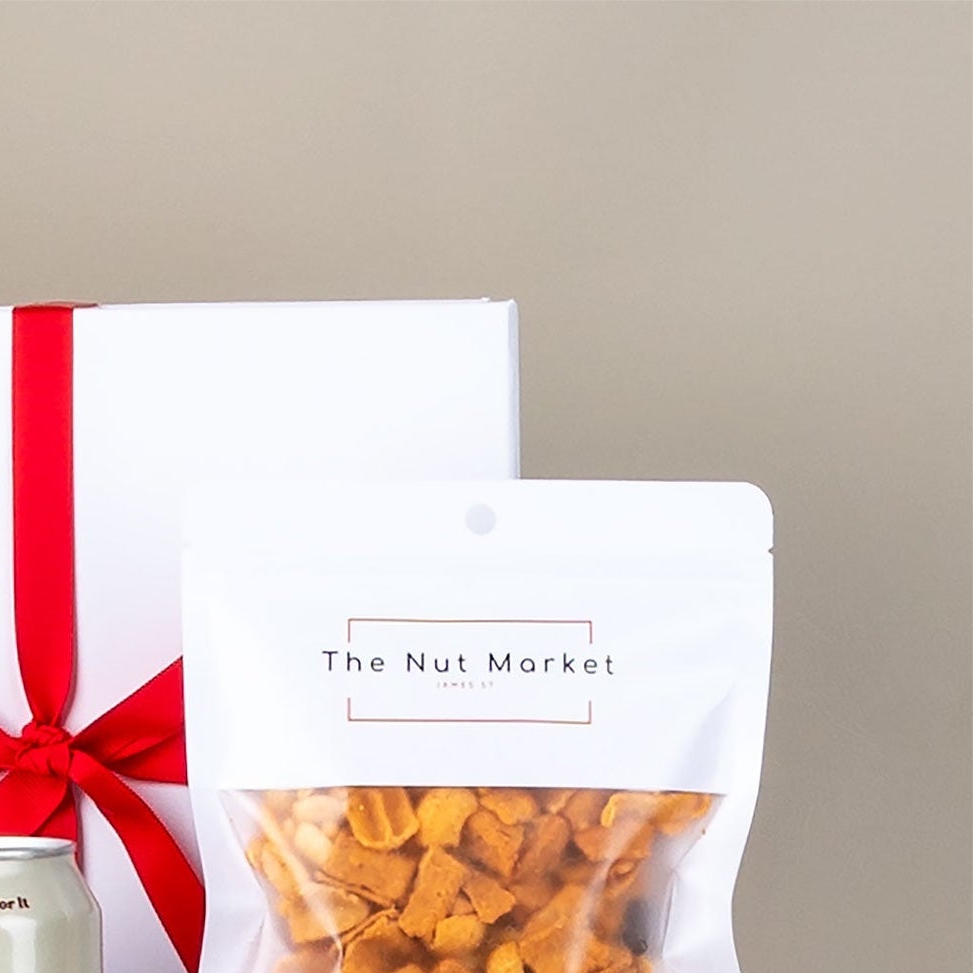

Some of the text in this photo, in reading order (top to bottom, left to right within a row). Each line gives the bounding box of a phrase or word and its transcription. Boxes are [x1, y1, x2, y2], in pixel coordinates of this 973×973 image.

[322, 650, 614, 675] The Nut Market
[18, 897, 30, 910] It
